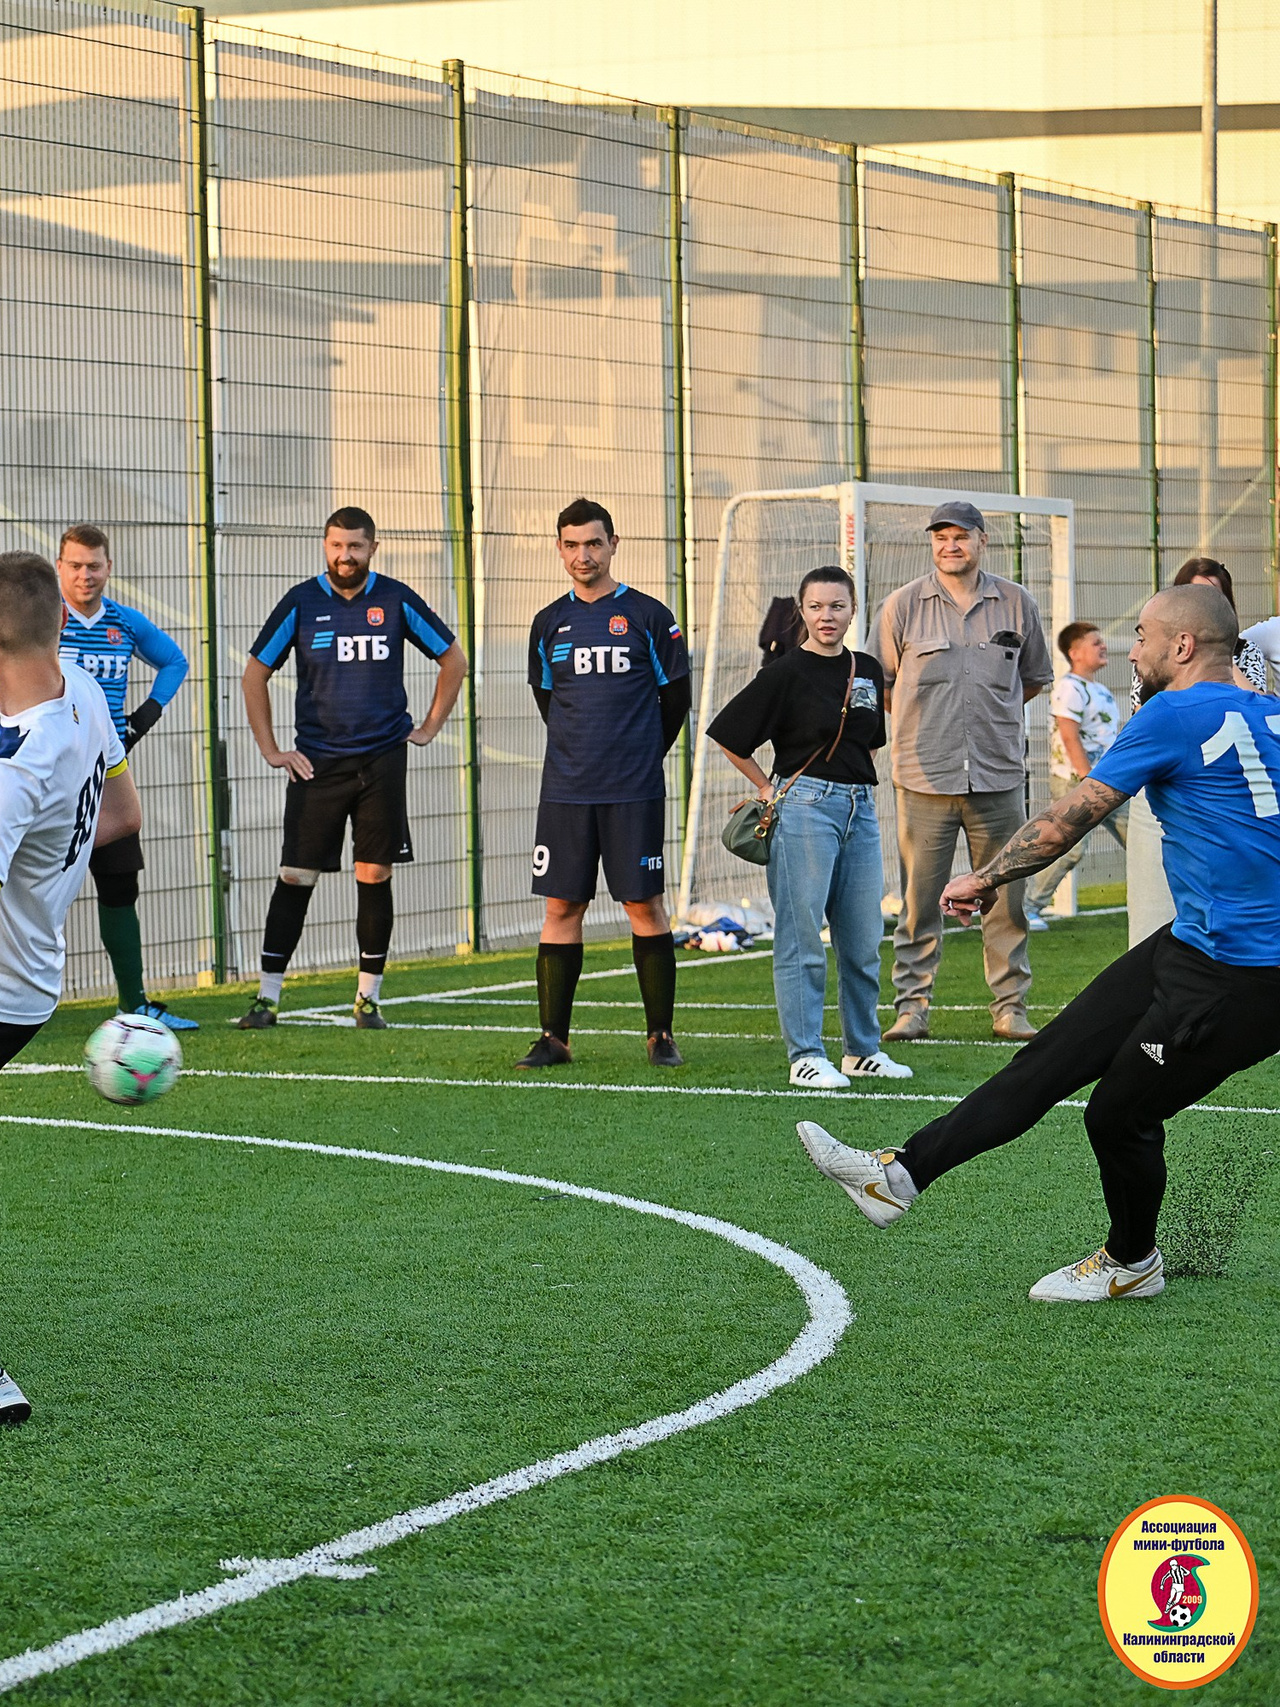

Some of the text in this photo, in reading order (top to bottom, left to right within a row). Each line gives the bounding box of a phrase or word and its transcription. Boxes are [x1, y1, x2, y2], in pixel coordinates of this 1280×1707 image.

[337, 635, 390, 662] ВТБ
[574, 646, 631, 675] ВТБ
[83, 653, 127, 679] ВТБ
[1200, 710, 1280, 818] 1
[532, 845, 550, 877] 9
[1140, 1042, 1165, 1065] adidas
